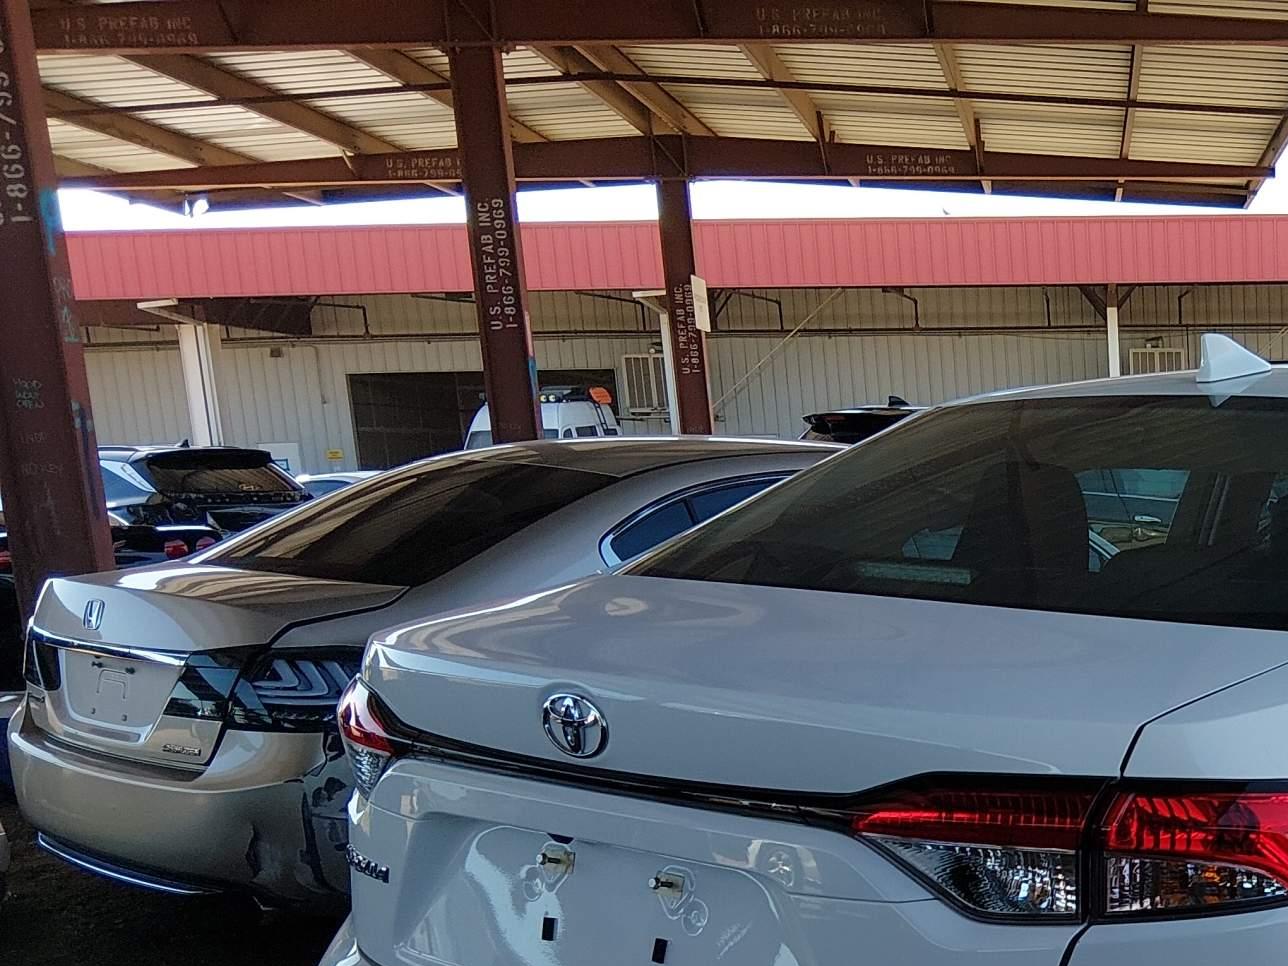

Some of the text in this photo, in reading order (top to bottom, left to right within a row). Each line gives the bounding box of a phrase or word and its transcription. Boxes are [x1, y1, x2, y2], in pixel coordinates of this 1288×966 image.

[480, 234, 500, 293] PREFAB
[491, 198, 519, 329] 1-866-799-0969
[489, 301, 504, 331] U.S.
[674, 308, 690, 349] PREFAB
